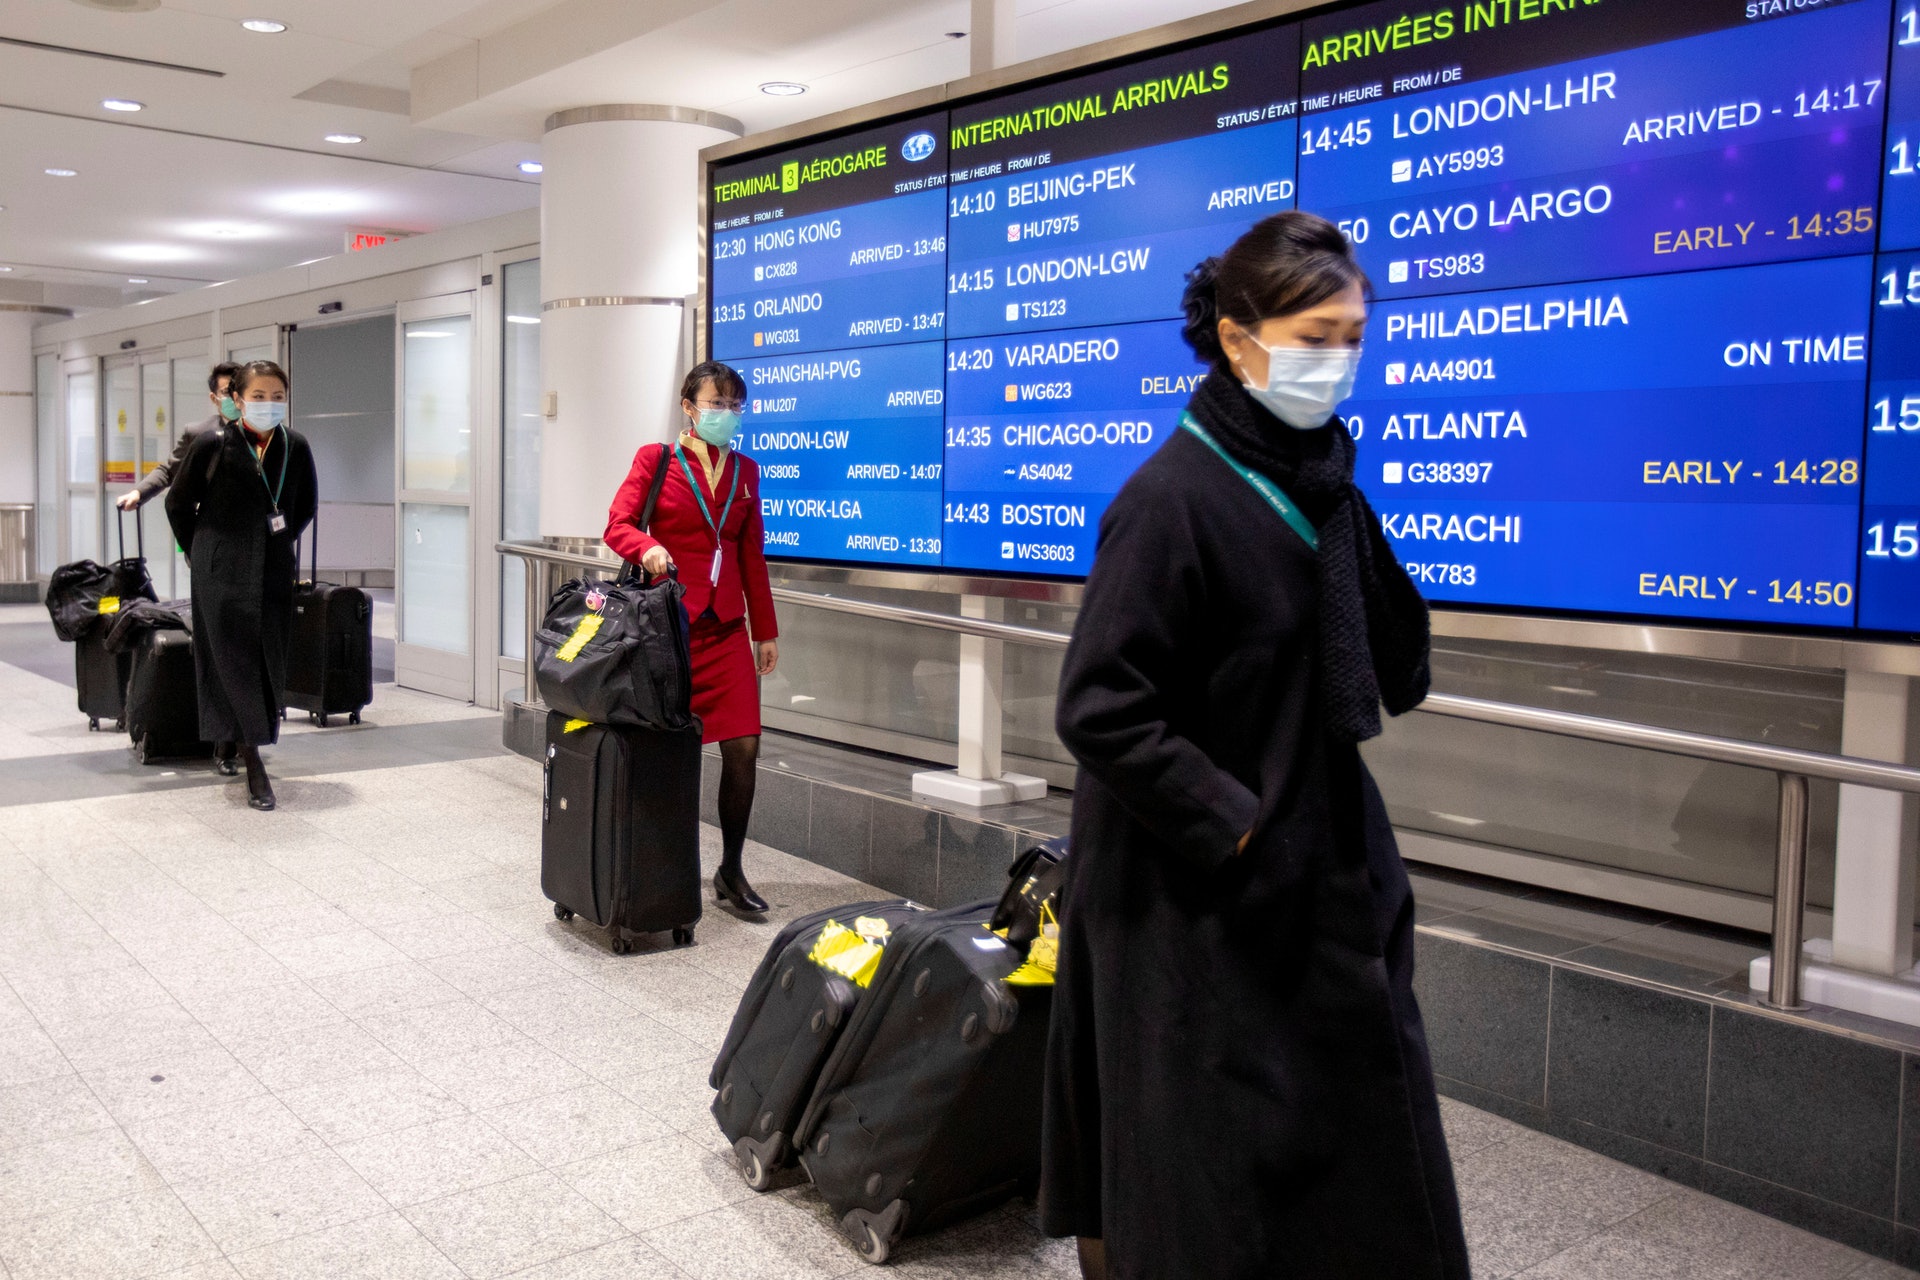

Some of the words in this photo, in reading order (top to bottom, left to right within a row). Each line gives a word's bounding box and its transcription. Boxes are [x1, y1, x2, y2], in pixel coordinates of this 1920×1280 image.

[1302, 11, 1454, 70] ARRIVÉES
[1301, 96, 1329, 112] TIME
[1339, 85, 1382, 104] HEURE
[1393, 75, 1431, 93] FROM
[1442, 68, 1461, 82] DE
[951, 96, 1107, 150] INTERNATIONAL
[1111, 65, 1229, 114] ARRIVALS
[1217, 110, 1260, 129] STATUS
[1268, 102, 1298, 119] ÉTAT
[1301, 119, 1372, 155] 14:45
[1393, 72, 1616, 139] LONDON-LHR
[1622, 102, 1761, 145] ARRIVED
[1793, 80, 1882, 118] 14:17
[714, 173, 780, 203] TERMINAL
[801, 147, 887, 184] AÉROGARE
[951, 170, 969, 183] TIME
[973, 164, 1002, 179] HEURE
[1008, 157, 1032, 171] FROM
[1038, 153, 1050, 165] DE
[1416, 145, 1504, 179] AY5993
[895, 178, 924, 194] STATUS
[927, 173, 947, 187] ÉTAT
[951, 190, 995, 218] 14:10
[1008, 164, 1136, 207] BEIJING-PEK
[1207, 180, 1294, 211] ARRIVED
[714, 220, 727, 231] TIME
[730, 215, 750, 228] HEURE
[754, 211, 772, 222] FROM
[775, 208, 784, 218] DE
[1389, 203, 1477, 239] CAYO
[1488, 185, 1612, 227] LARGO
[714, 237, 746, 260] 12:30
[754, 228, 795, 253] HONG
[799, 220, 842, 245] KONG
[1023, 215, 1080, 240] HU7975
[1653, 221, 1755, 254] EARLY
[1786, 207, 1873, 240] 14:35
[850, 243, 903, 267] ARRIVED
[913, 237, 946, 256] 13:46
[765, 262, 797, 279] CX828
[949, 269, 993, 294] 14:15
[1006, 248, 1150, 287] LONDON-LGW
[1414, 253, 1485, 280] TS983
[714, 303, 745, 323] 13:15
[754, 292, 823, 318] ORLANDO
[1022, 300, 1066, 321] TS123
[1387, 297, 1628, 341] PHILADELPHIA
[765, 328, 800, 345] WG031
[849, 317, 902, 338] ARRIVED
[912, 312, 945, 331] 13:47
[948, 349, 993, 371] 14:20
[1005, 338, 1119, 368] VARADERO
[1723, 342, 1771, 367] ON
[1782, 336, 1865, 364] TIME
[753, 359, 861, 385] SHANGHAI-PVG
[1410, 359, 1496, 383] AA4901
[887, 389, 943, 408] ARRIVED
[1021, 382, 1072, 400] WG623
[764, 397, 797, 413] MU207
[946, 426, 991, 448] 14:35
[1003, 422, 1153, 446] CHICAGO-ORD
[1382, 411, 1528, 441] ATLANTA
[752, 430, 850, 450] LONDON-LGW
[763, 464, 800, 480] VS8005
[847, 464, 900, 480] ARRIVED
[910, 464, 942, 480] 14:07
[1019, 464, 1073, 481] AS4042
[1408, 462, 1493, 483] G38397
[1643, 461, 1743, 483] EARLY
[1773, 459, 1859, 485] 14:28
[761, 498, 784, 517] EW
[786, 500, 862, 520] YORK-LGA
[945, 503, 990, 524] 14:43
[1002, 504, 1085, 527] BOSTON
[1382, 513, 1521, 543] KARACHI
[846, 535, 899, 552] ARRIVED
[909, 538, 941, 554] 13:30
[1017, 543, 1075, 562] WS3603
[1638, 573, 1738, 600] EARLY
[1768, 579, 1853, 607] 14:50
